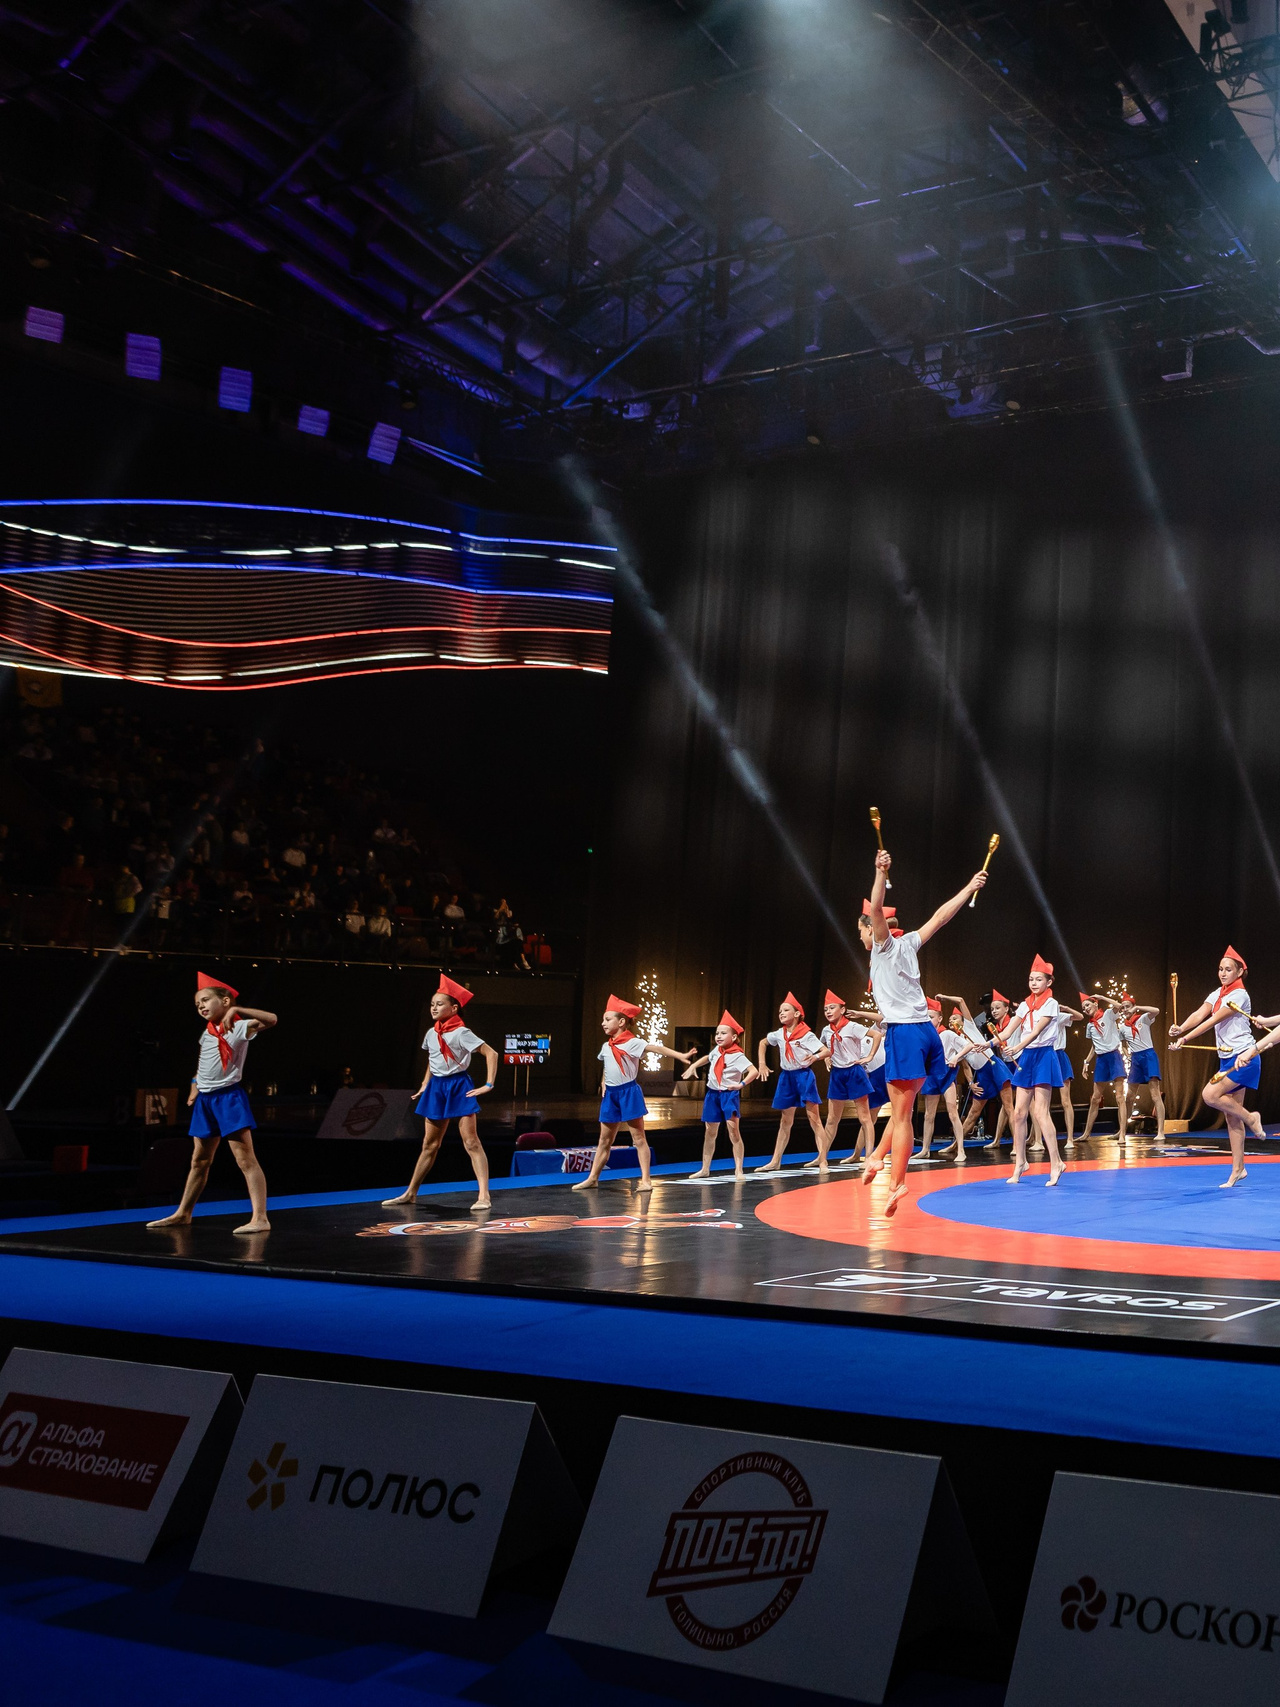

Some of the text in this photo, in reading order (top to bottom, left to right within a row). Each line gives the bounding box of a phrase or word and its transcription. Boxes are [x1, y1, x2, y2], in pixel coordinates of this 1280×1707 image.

[519, 1055, 535, 1064] VFA
[38, 1421, 106, 1449] АЛЬФА
[28, 1446, 159, 1484] СТРАХОВАНИЕ
[694, 1456, 808, 1504] СПОРТИВНЫЙ КЛУБ
[308, 1464, 481, 1524] ПОЛЮС
[743, 1587, 793, 1641] РОССИЯ
